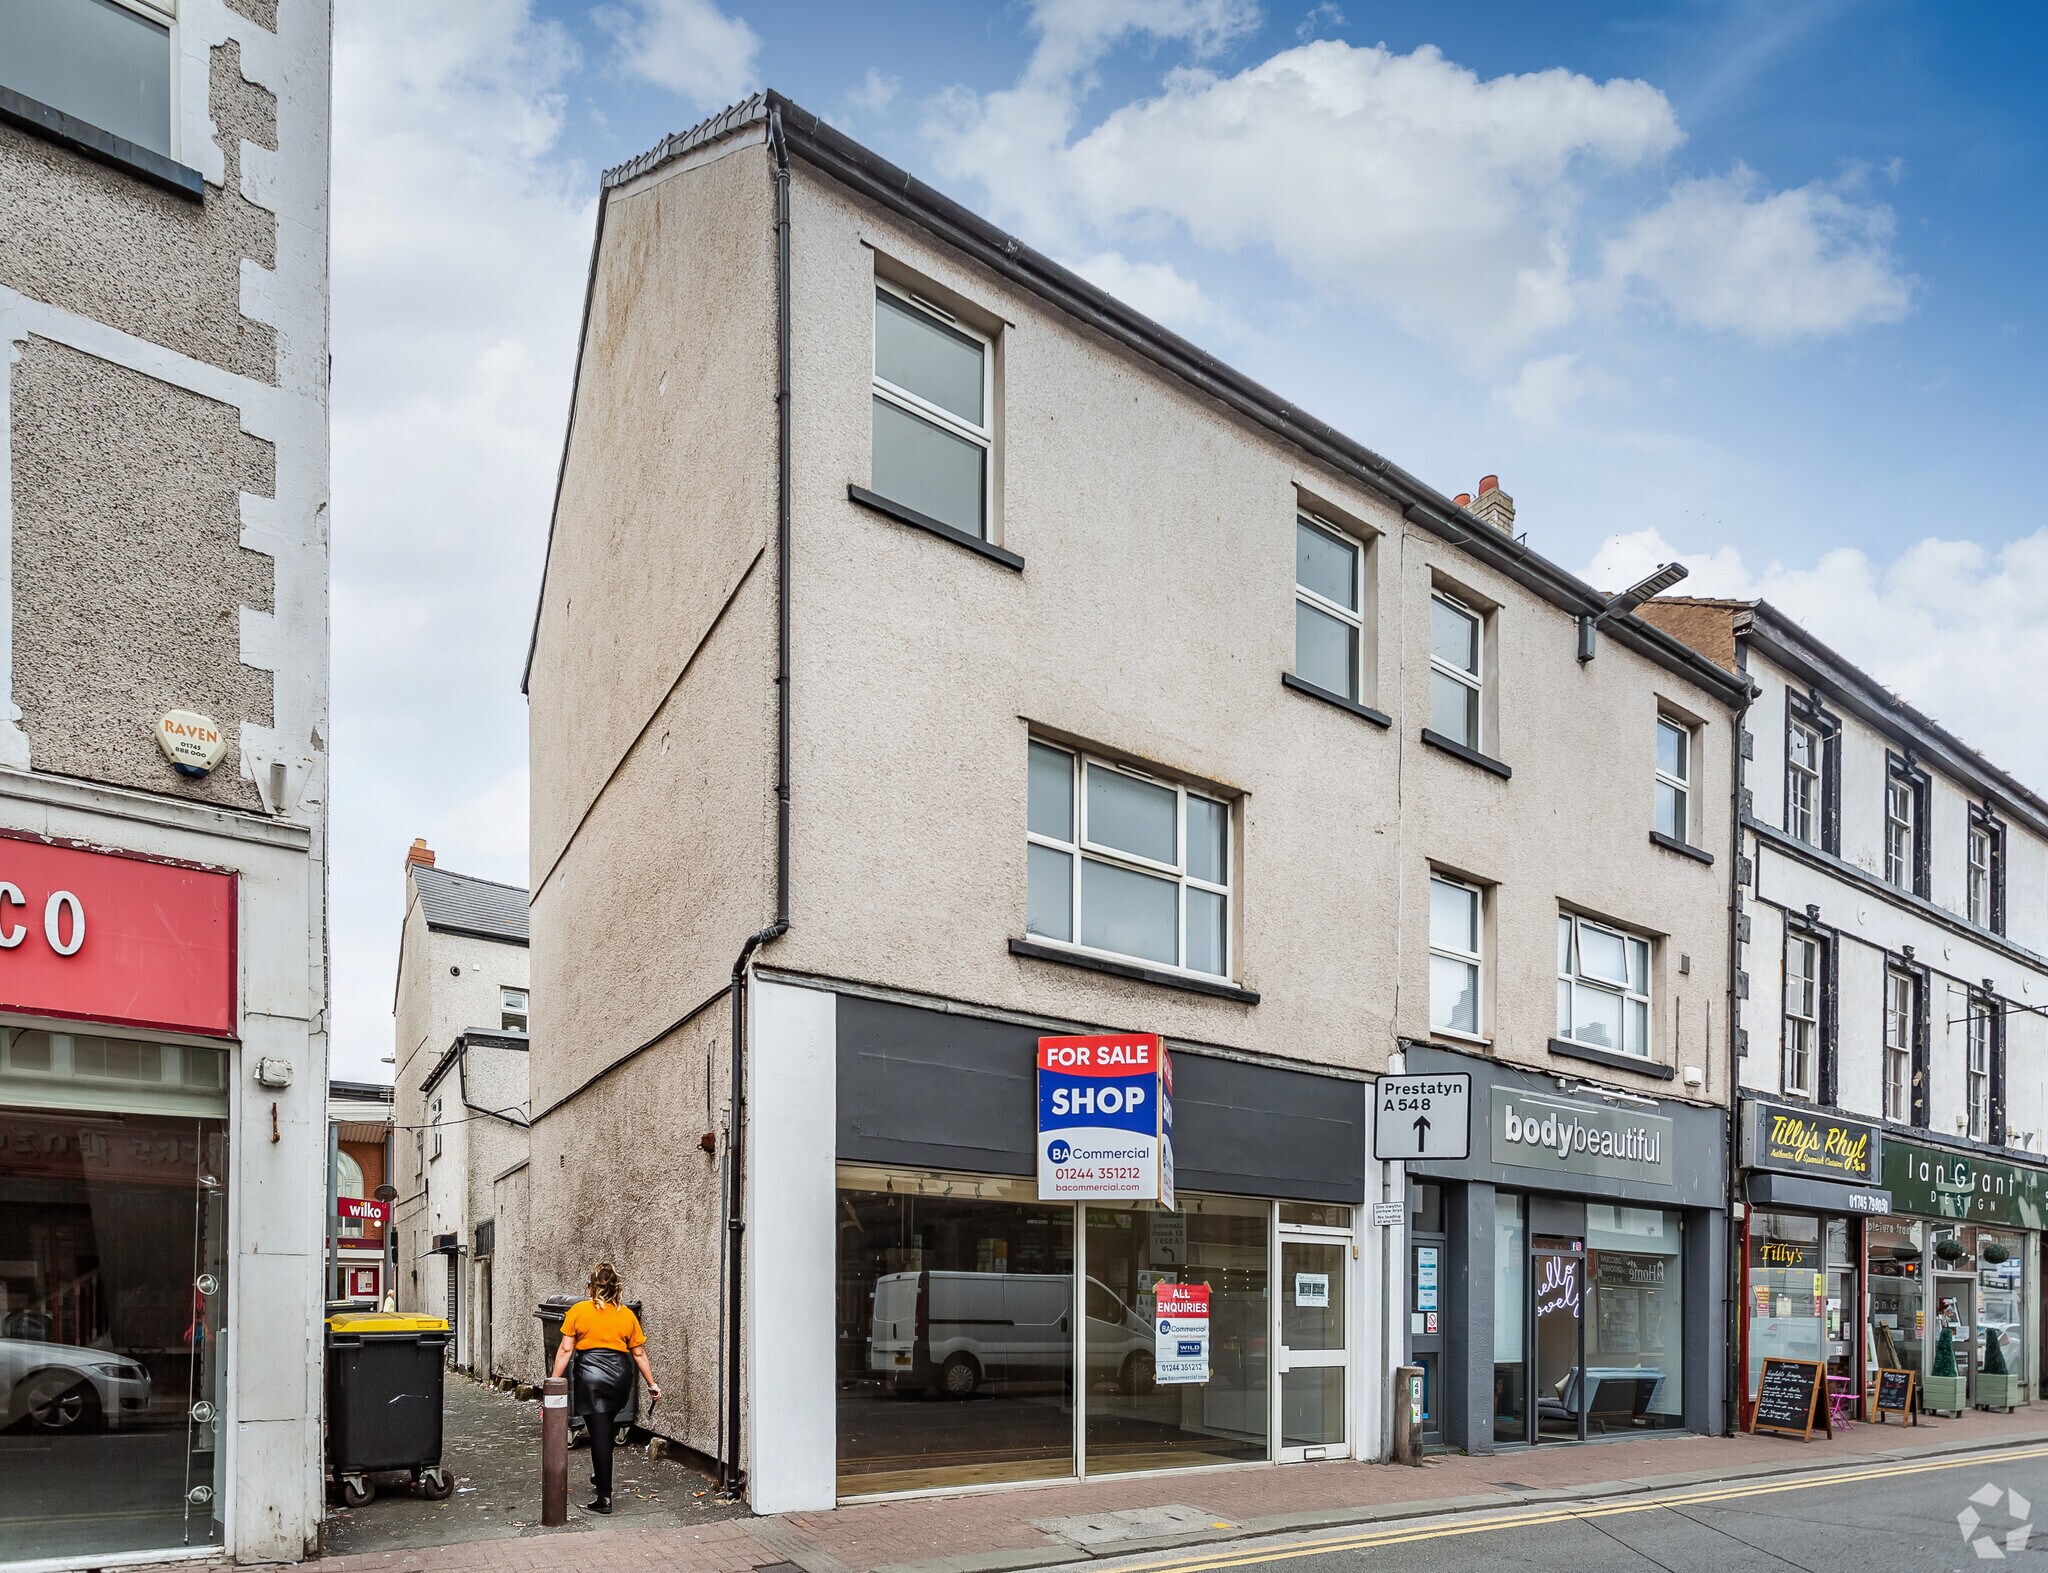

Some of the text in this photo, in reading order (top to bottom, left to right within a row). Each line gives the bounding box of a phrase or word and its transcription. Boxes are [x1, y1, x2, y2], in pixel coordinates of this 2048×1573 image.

[164, 719, 218, 744] RAVEN
[180, 742, 202, 750] 01745
[1047, 1044, 1149, 1067] FOR SALE
[1384, 1081, 1463, 1097] Prestatyn
[1051, 1086, 1146, 1116] SHOP
[1505, 1104, 1662, 1165] bodybeautiful
[1770, 1115, 1868, 1171] Tilly's Rhyl
[1052, 1147, 1150, 1161] BA Commercial
[1055, 1167, 1140, 1180] 01244 351212
[1055, 1183, 1140, 1192] bacommercial.com
[349, 1201, 382, 1219] wilko
[1849, 1194, 1868, 1210] 01745
[1760, 1243, 1803, 1267] Tilly's
[1172, 1288, 1191, 1299] ALL
[1157, 1302, 1208, 1313] ENQUIRIES
[1162, 1363, 1202, 1372] 01244 351212
